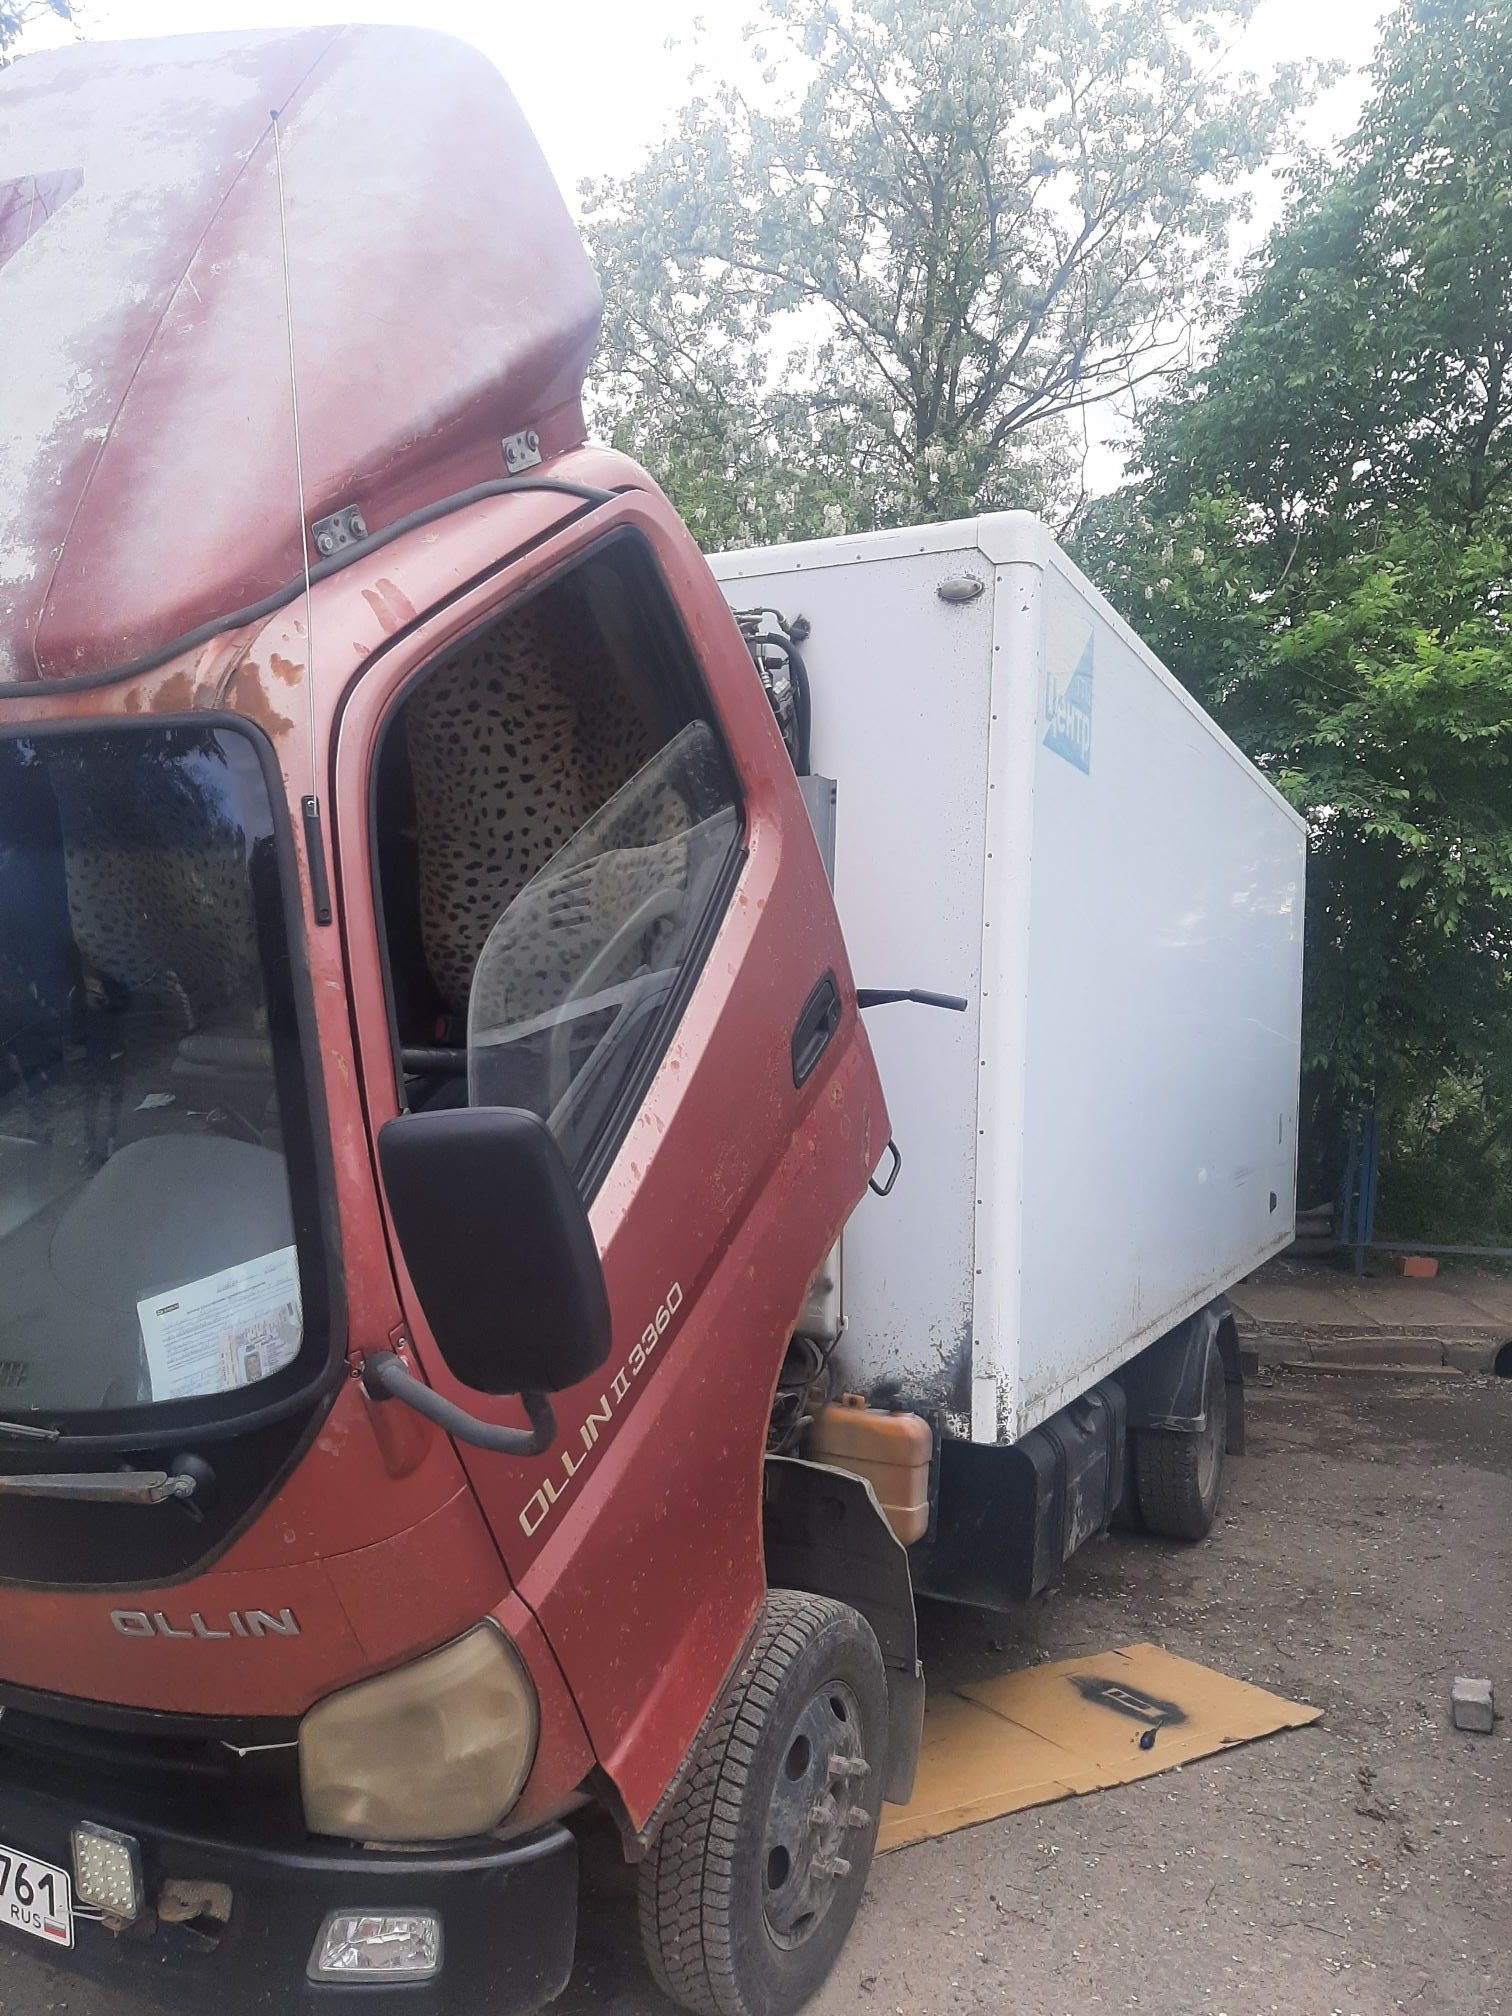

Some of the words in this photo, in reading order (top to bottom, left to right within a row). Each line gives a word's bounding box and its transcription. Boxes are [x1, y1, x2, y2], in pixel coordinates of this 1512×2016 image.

[518, 1394, 613, 1537] OLLIN
[610, 1366, 631, 1404] II
[628, 1281, 684, 1377] 3360
[110, 1608, 301, 1639] OLLIN
[0, 1854, 55, 1917] 761
[10, 1904, 42, 1929] RUS
